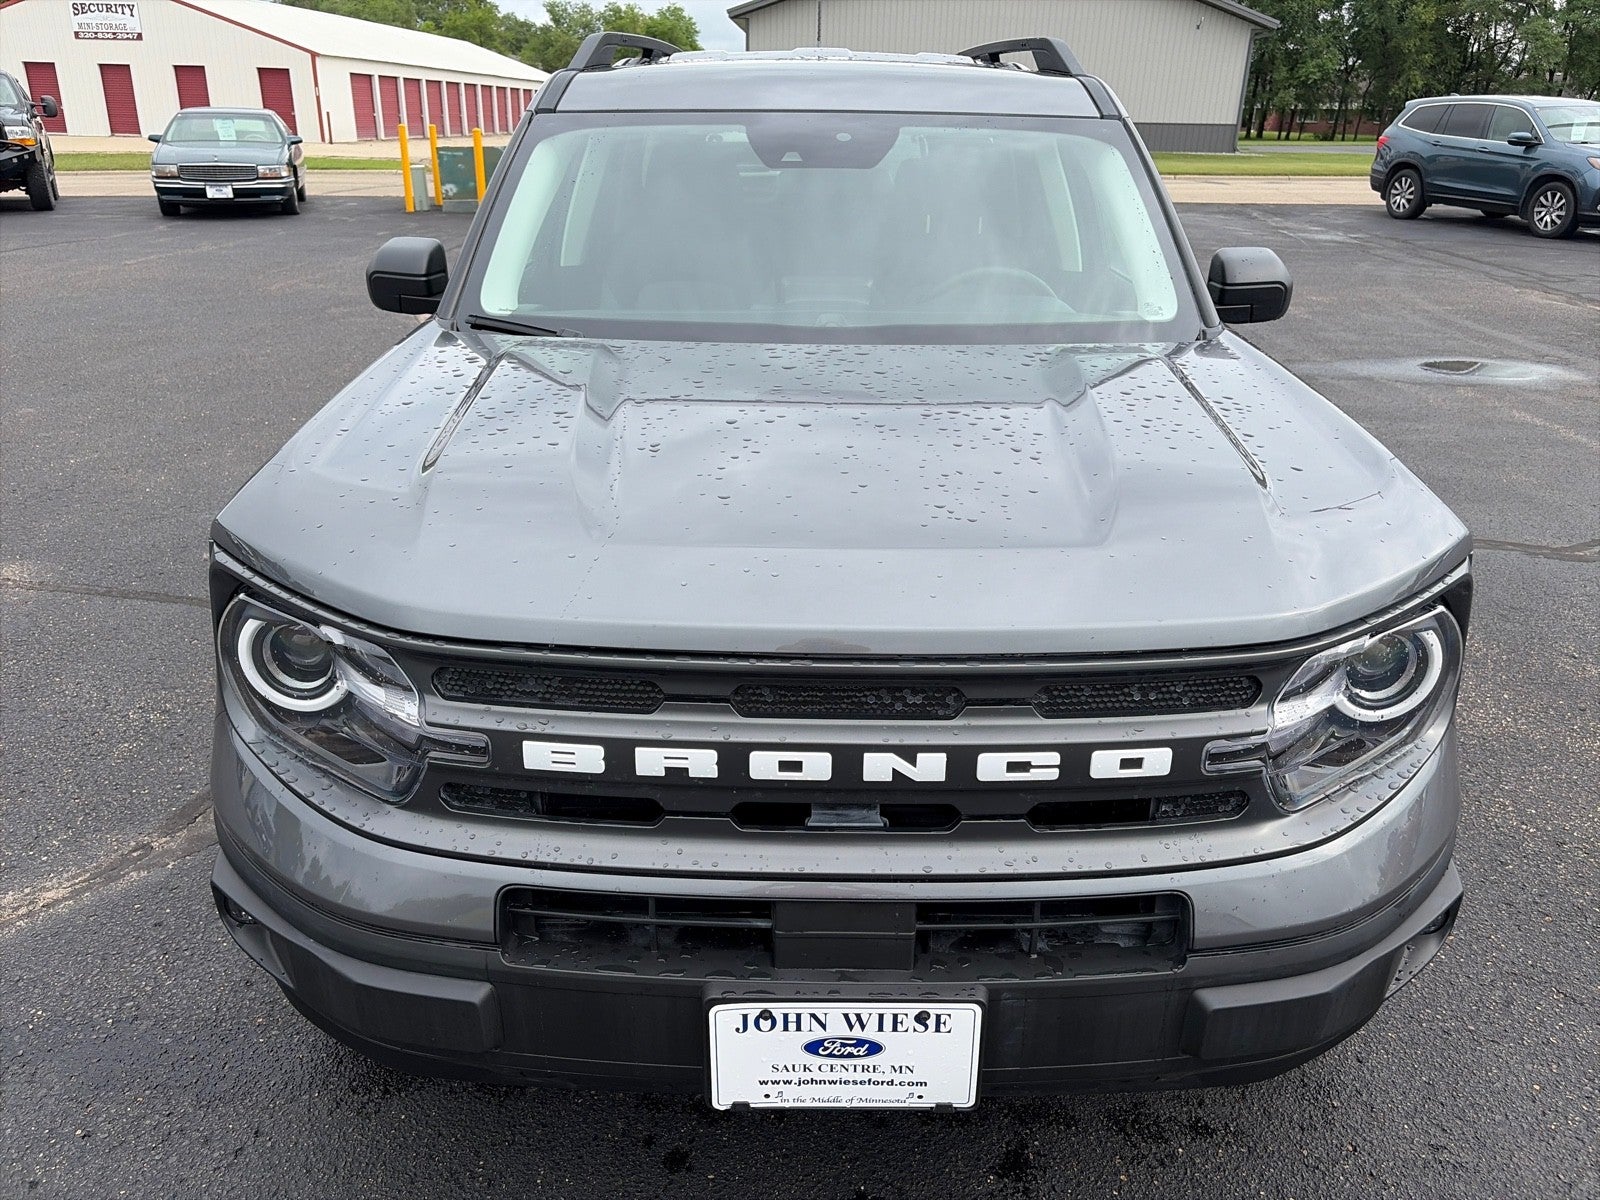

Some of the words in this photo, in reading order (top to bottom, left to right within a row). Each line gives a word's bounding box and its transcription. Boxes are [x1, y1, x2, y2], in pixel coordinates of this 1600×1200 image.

[72, 2, 135, 17] SECURITY
[77, 22, 128, 31] MINI-STORAGE
[522, 740, 1173, 781] BRONCO
[735, 1012, 829, 1034] JOHN
[841, 1012, 952, 1034] WIESE
[818, 1039, 870, 1056] Ford
[771, 1063, 813, 1073] SAUK
[818, 1064, 886, 1075] CENTRE,
[890, 1065, 915, 1075] MN
[758, 1077, 928, 1087] www.johnwieseford.com
[780, 1096, 790, 1104] in
[793, 1096, 806, 1104] the
[809, 1096, 842, 1104] Middle
[845, 1096, 854, 1107] of
